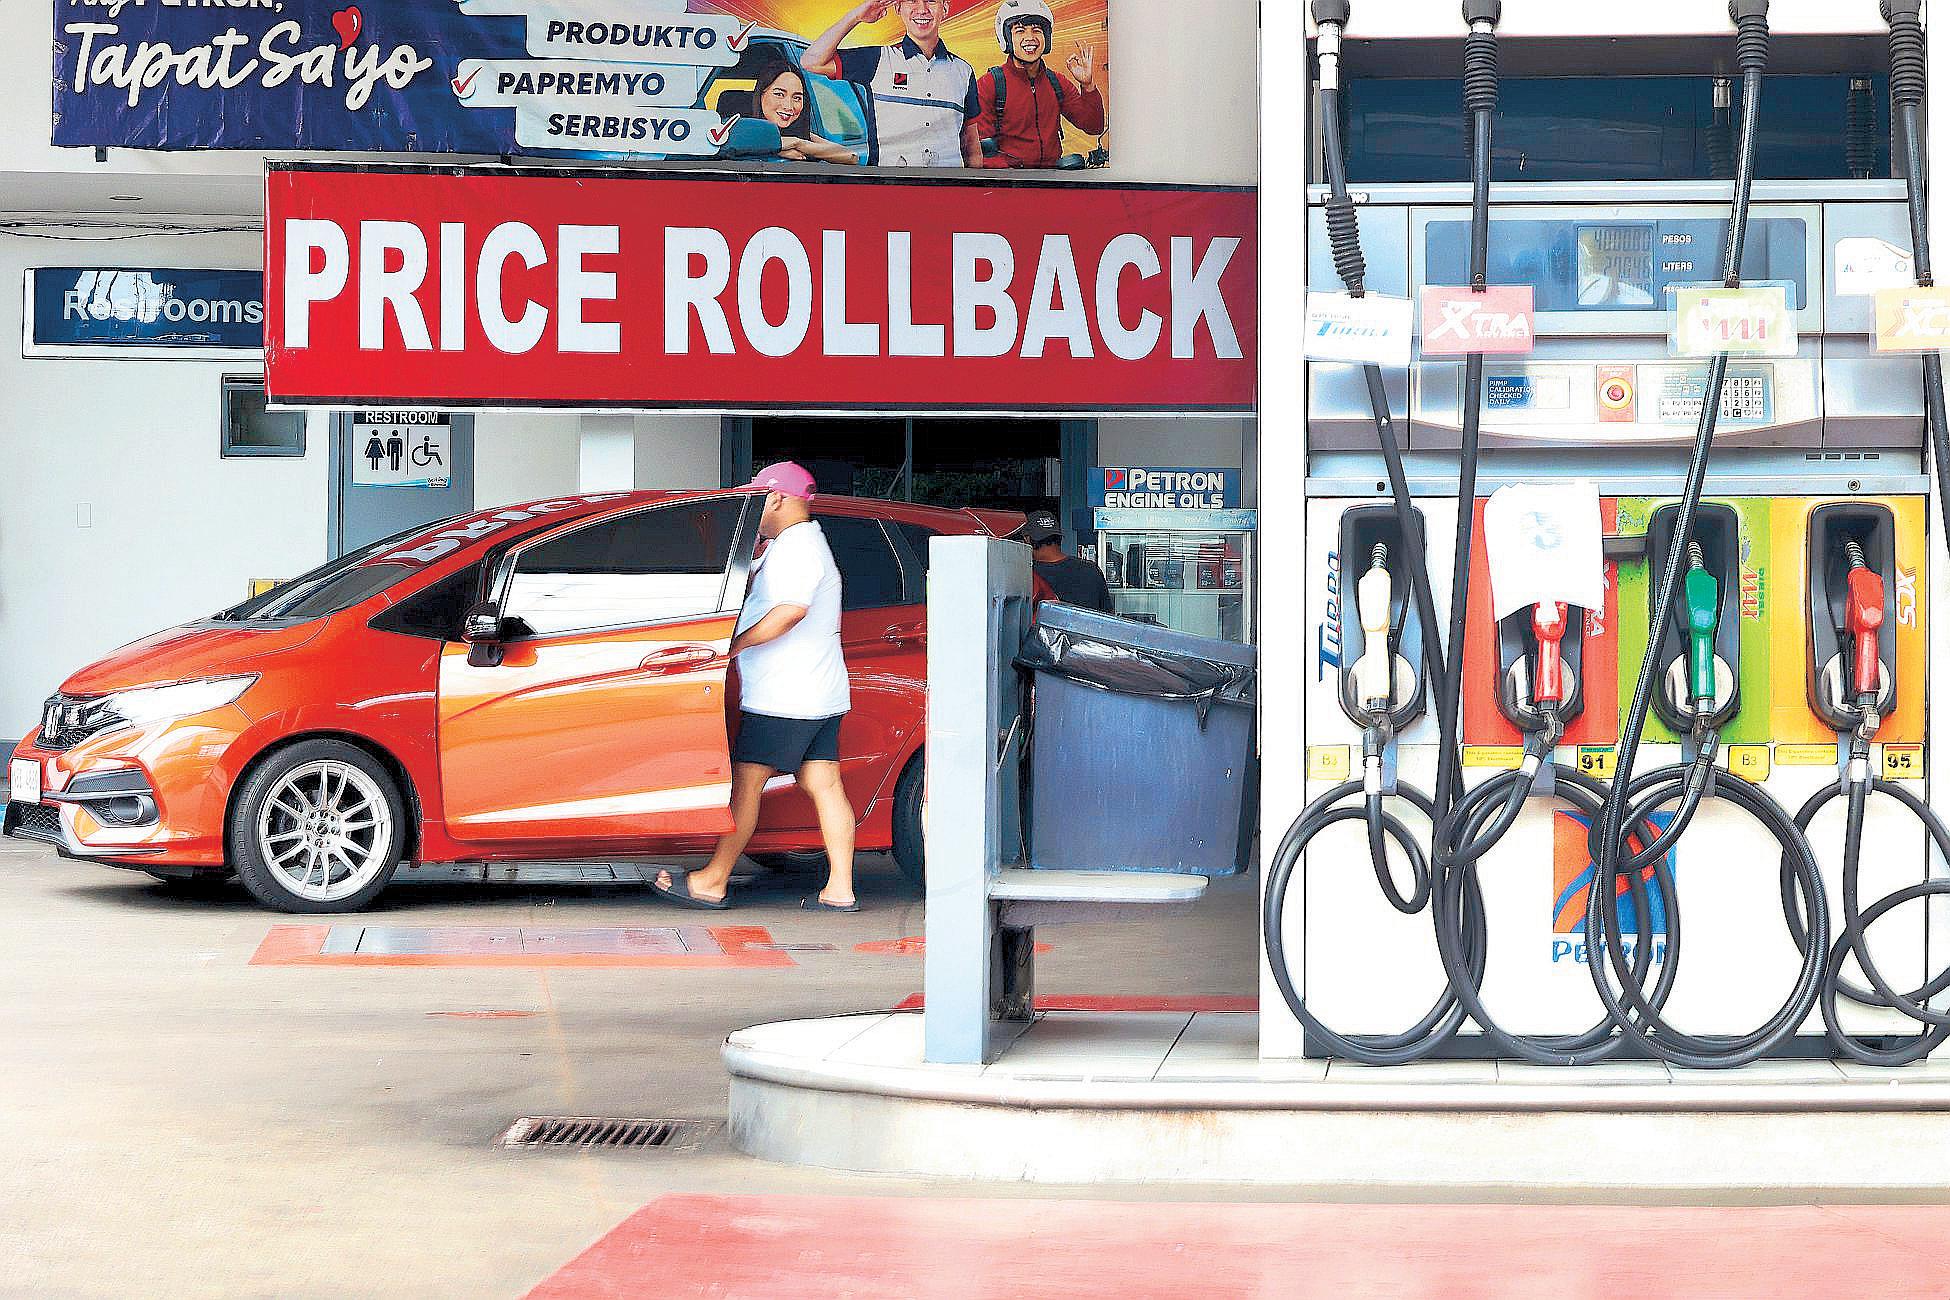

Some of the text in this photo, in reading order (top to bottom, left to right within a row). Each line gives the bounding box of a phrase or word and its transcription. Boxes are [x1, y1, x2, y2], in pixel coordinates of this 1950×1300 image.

[546, 20, 717, 50] PRODUKTO
[65, 22, 258, 108] Tapat
[497, 72, 666, 96] PAPREMYO
[546, 113, 691, 142] SERBISYO
[1662, 235, 1692, 244] PESOS
[1662, 262, 1693, 271] LITERS
[283, 217, 1244, 361] PRICE ROLLBACK
[63, 289, 264, 323] Rooms
[1428, 301, 1531, 340] XTRA
[365, 411, 439, 424] RESTROOM
[1129, 468, 1224, 491] PETRON
[1104, 492, 1224, 508] ENGINE OILS
[1742, 565, 1761, 622] MAX
[1582, 754, 1604, 769] 91
[1887, 753, 1911, 768] 95
